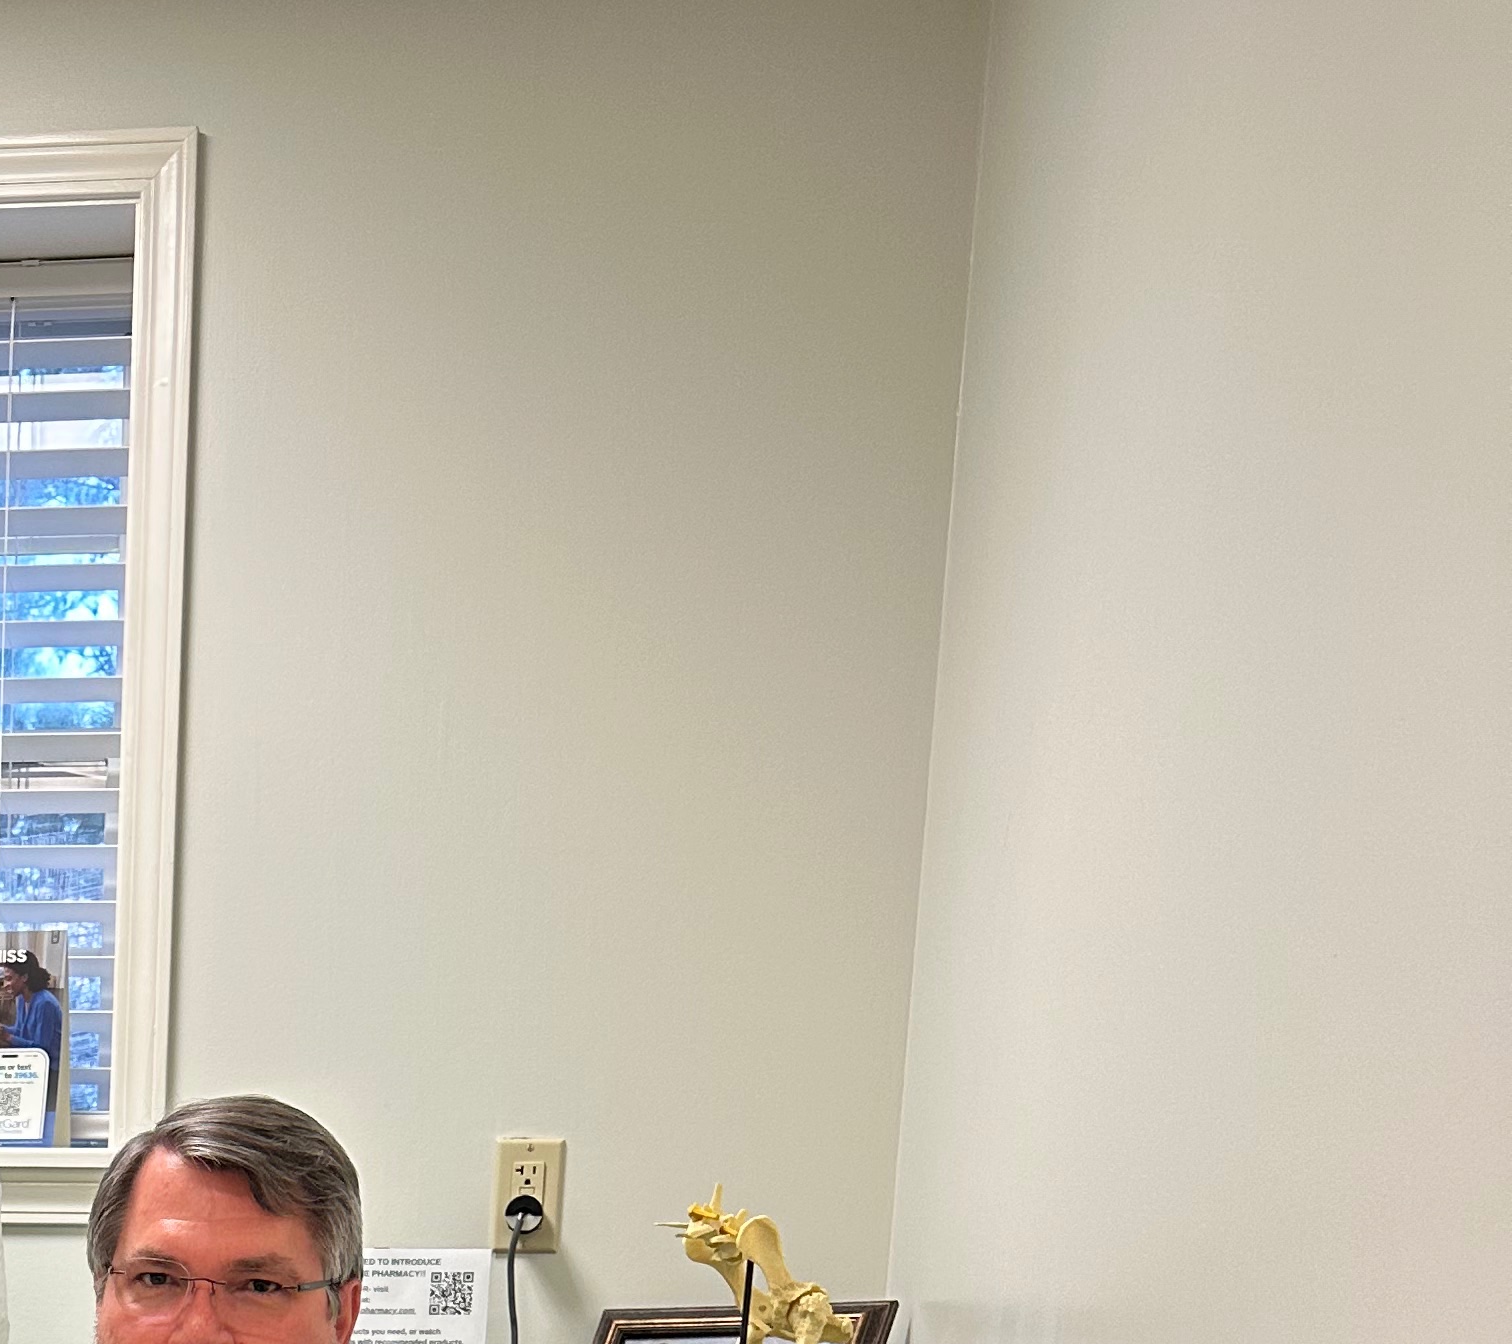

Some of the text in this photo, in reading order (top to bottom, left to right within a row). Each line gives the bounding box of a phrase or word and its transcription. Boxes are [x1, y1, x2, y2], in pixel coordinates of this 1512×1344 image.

[377, 1258, 388, 1266] TO
[391, 1258, 442, 1266] INTRODUCE
[360, 1307, 416, 1315] pharmacy.com
